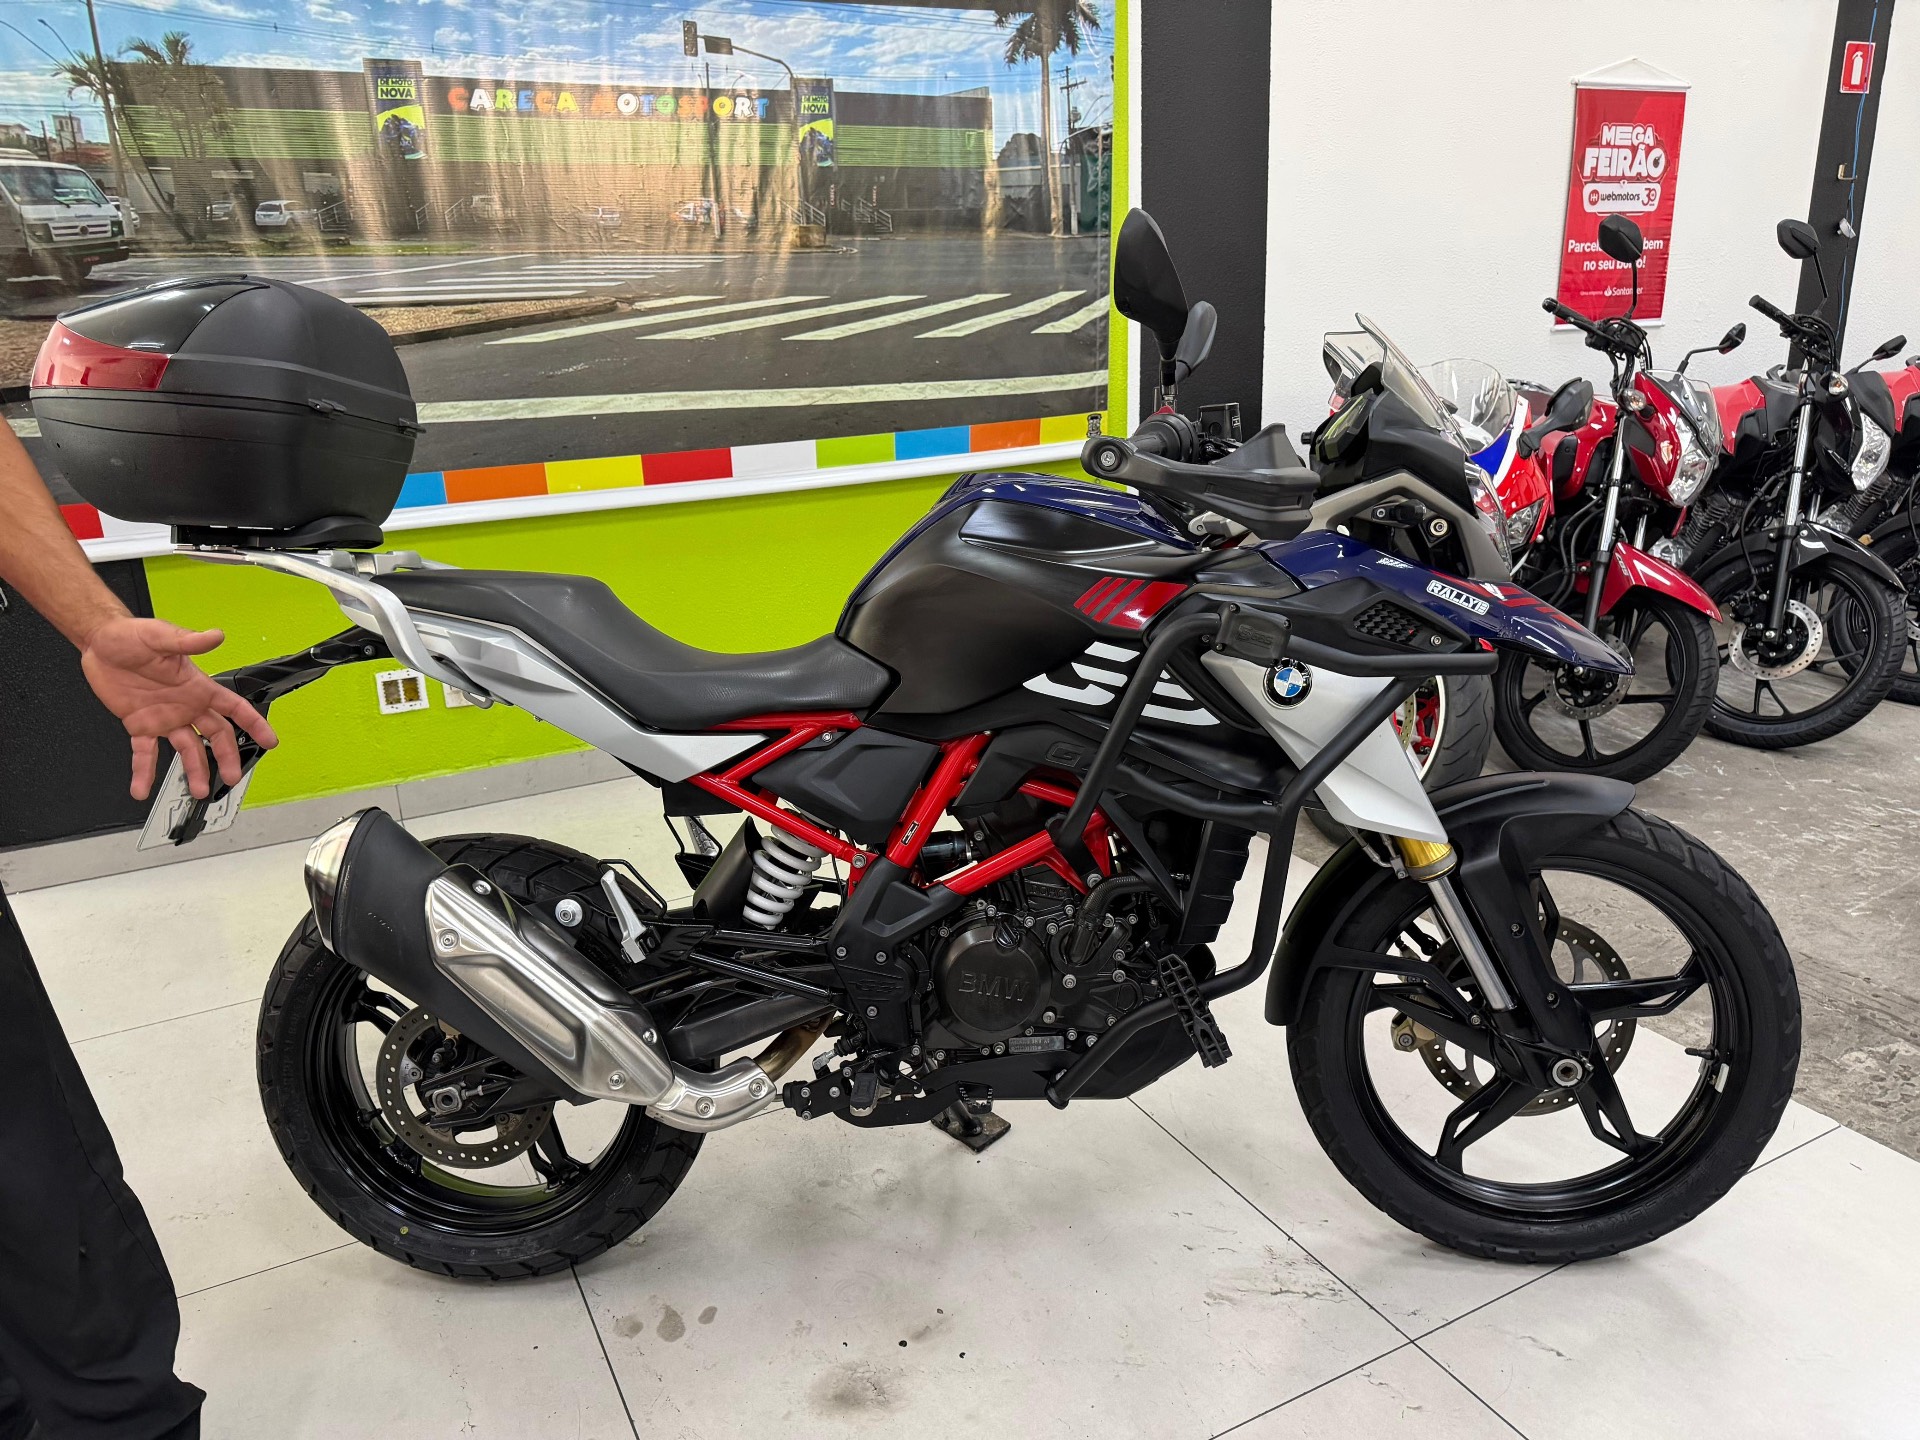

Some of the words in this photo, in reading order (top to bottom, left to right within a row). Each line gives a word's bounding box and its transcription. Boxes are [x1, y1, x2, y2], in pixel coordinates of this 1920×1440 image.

[380, 87, 413, 98] NOVA
[448, 86, 580, 113] CARECA
[802, 103, 827, 114] NOVA
[1601, 125, 1655, 147] MEGA
[1583, 143, 1666, 178] FEIRÃO
[1600, 190, 1640, 202] webmotors
[1567, 238, 1602, 253] Parcel
[1583, 261, 1597, 271] no
[1598, 260, 1615, 270] seu
[1612, 286, 1644, 296] Santaner
[1430, 581, 1489, 615] RALLYE
[958, 970, 1030, 1002] BMW
